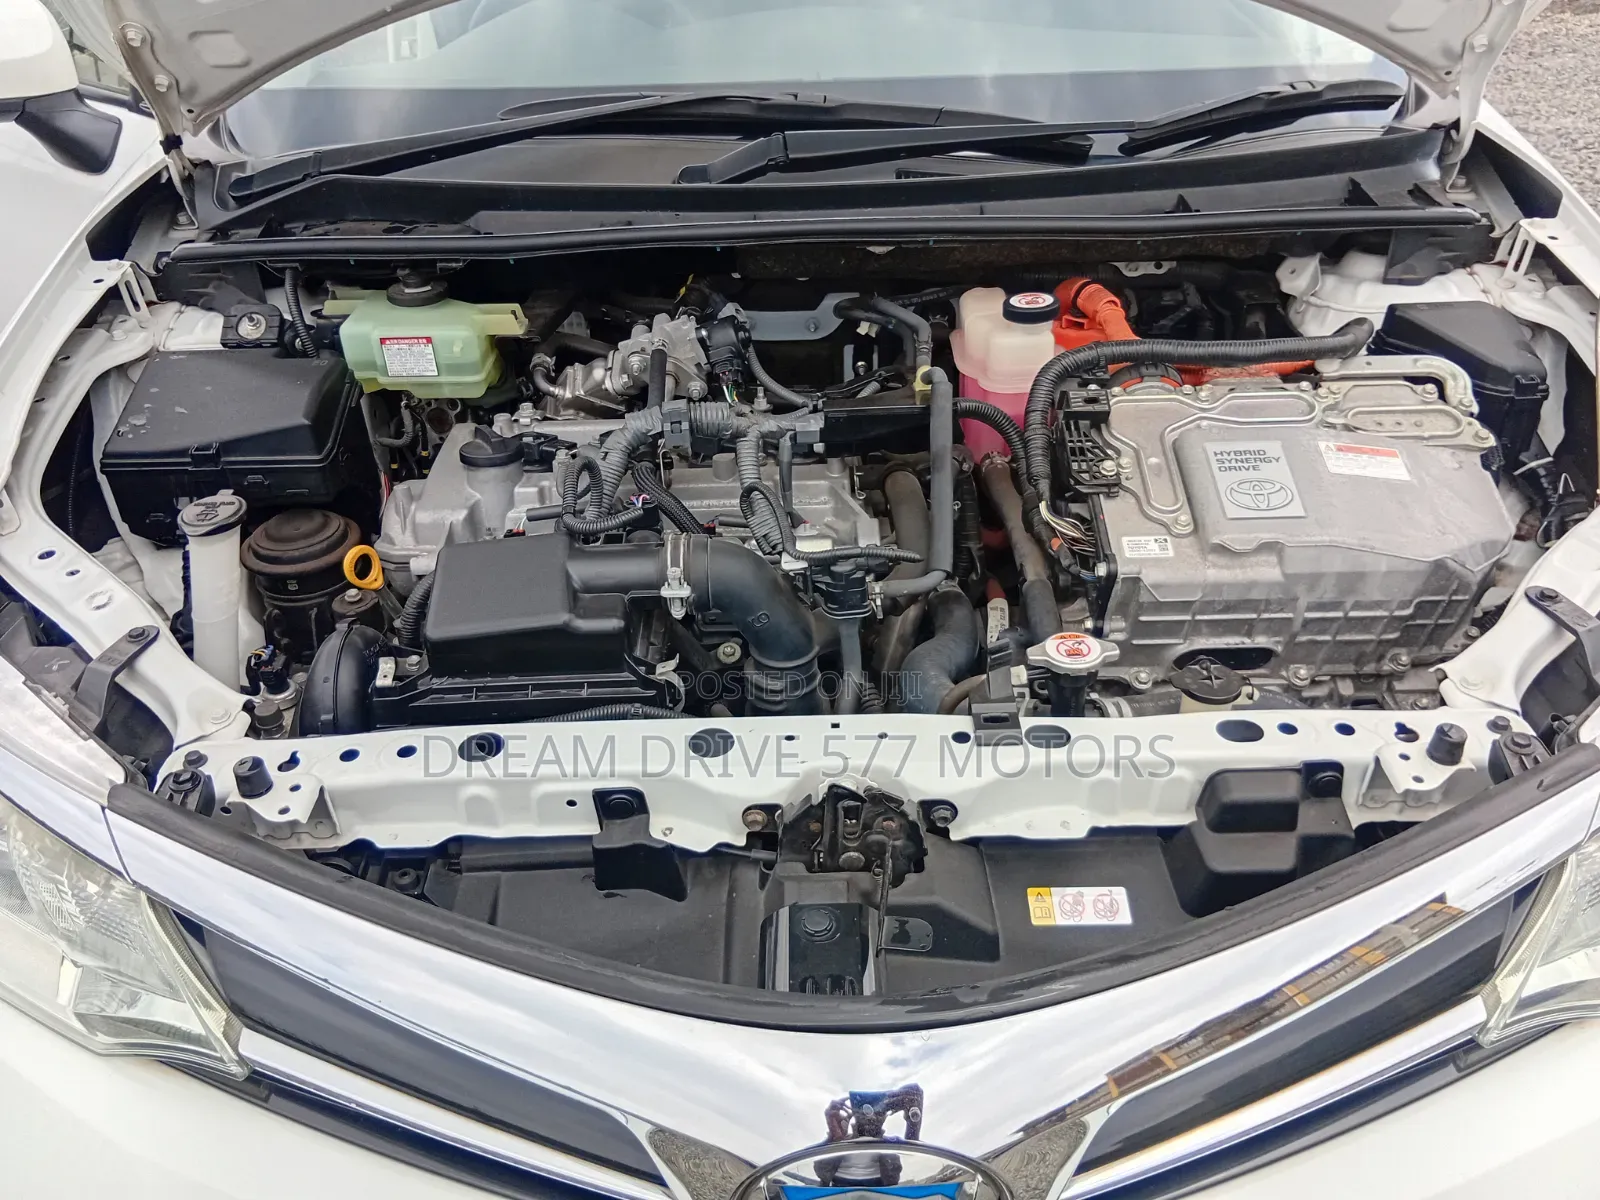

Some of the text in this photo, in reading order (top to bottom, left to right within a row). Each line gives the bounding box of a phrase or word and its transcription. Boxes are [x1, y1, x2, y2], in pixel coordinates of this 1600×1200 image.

[1213, 449, 1267, 457] HYBRID
[1215, 456, 1281, 465] SYNERGY
[1218, 464, 1261, 472] DRIVE
